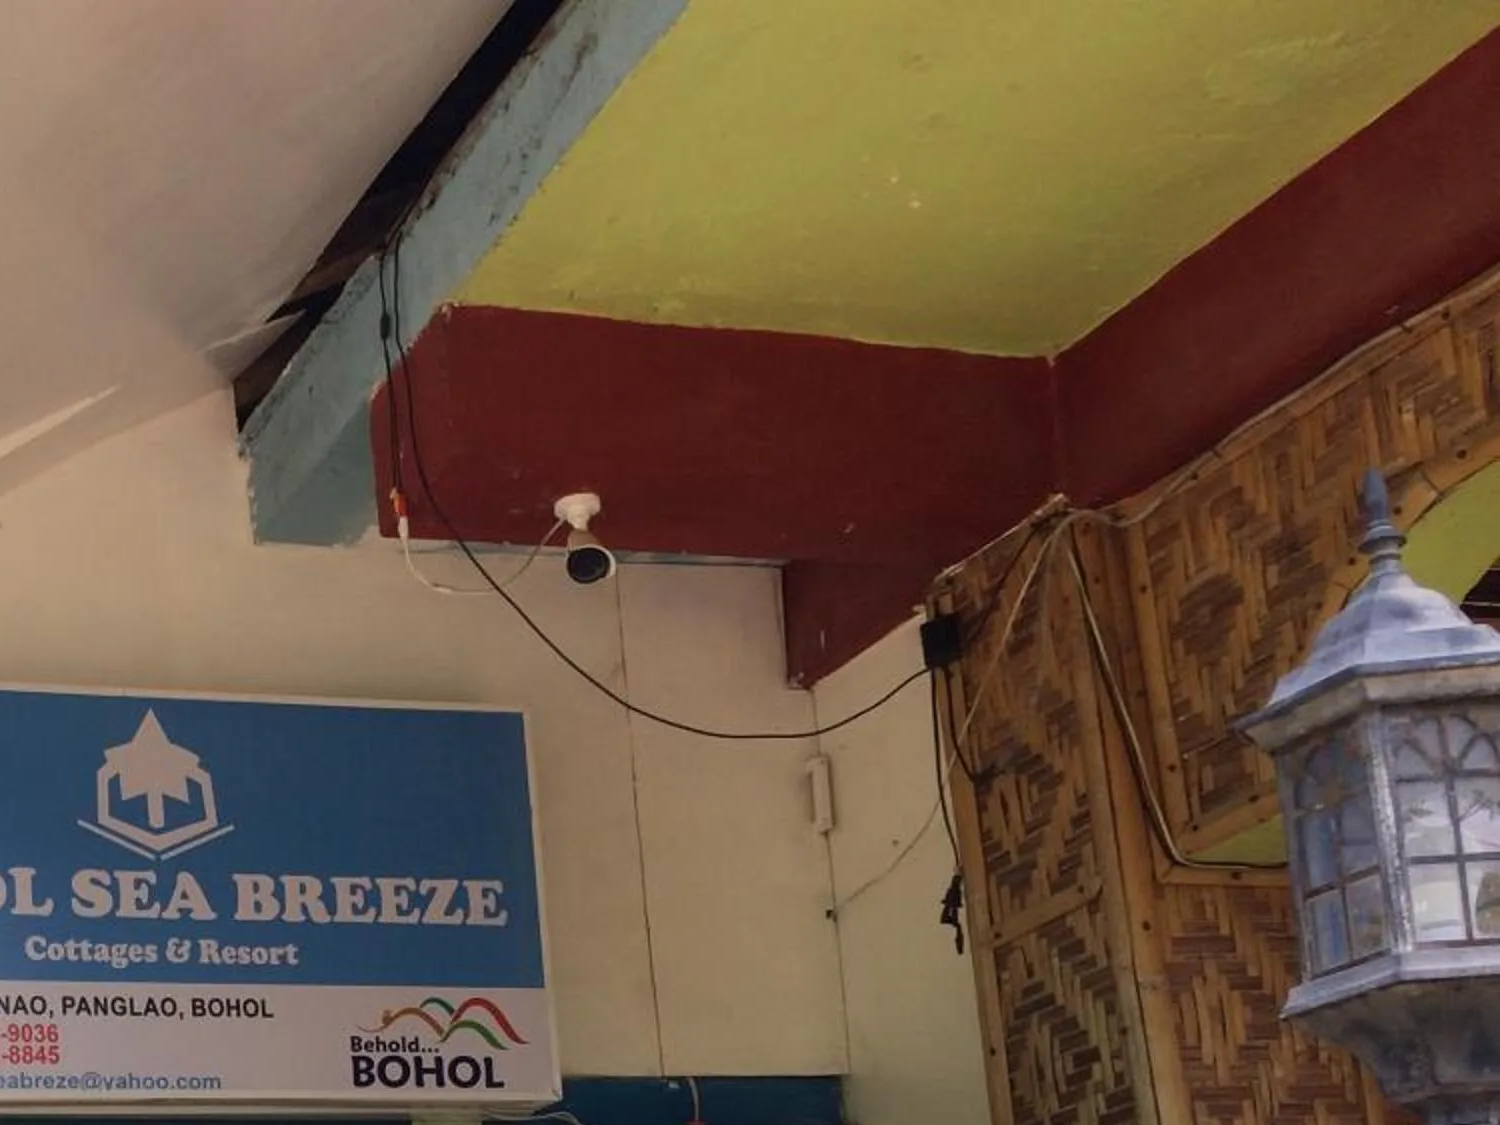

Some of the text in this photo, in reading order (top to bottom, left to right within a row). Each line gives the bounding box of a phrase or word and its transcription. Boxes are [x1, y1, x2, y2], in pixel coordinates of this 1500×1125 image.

[70, 868, 218, 922] SEA
[231, 872, 509, 927] BREEZE
[24, 935, 300, 970] Cottages & Resort
[61, 995, 185, 1021] PANGLAO,
[190, 997, 275, 1019] BOHOL
[349, 1035, 440, 1053] Behold...
[351, 1055, 505, 1089] BOHOL
